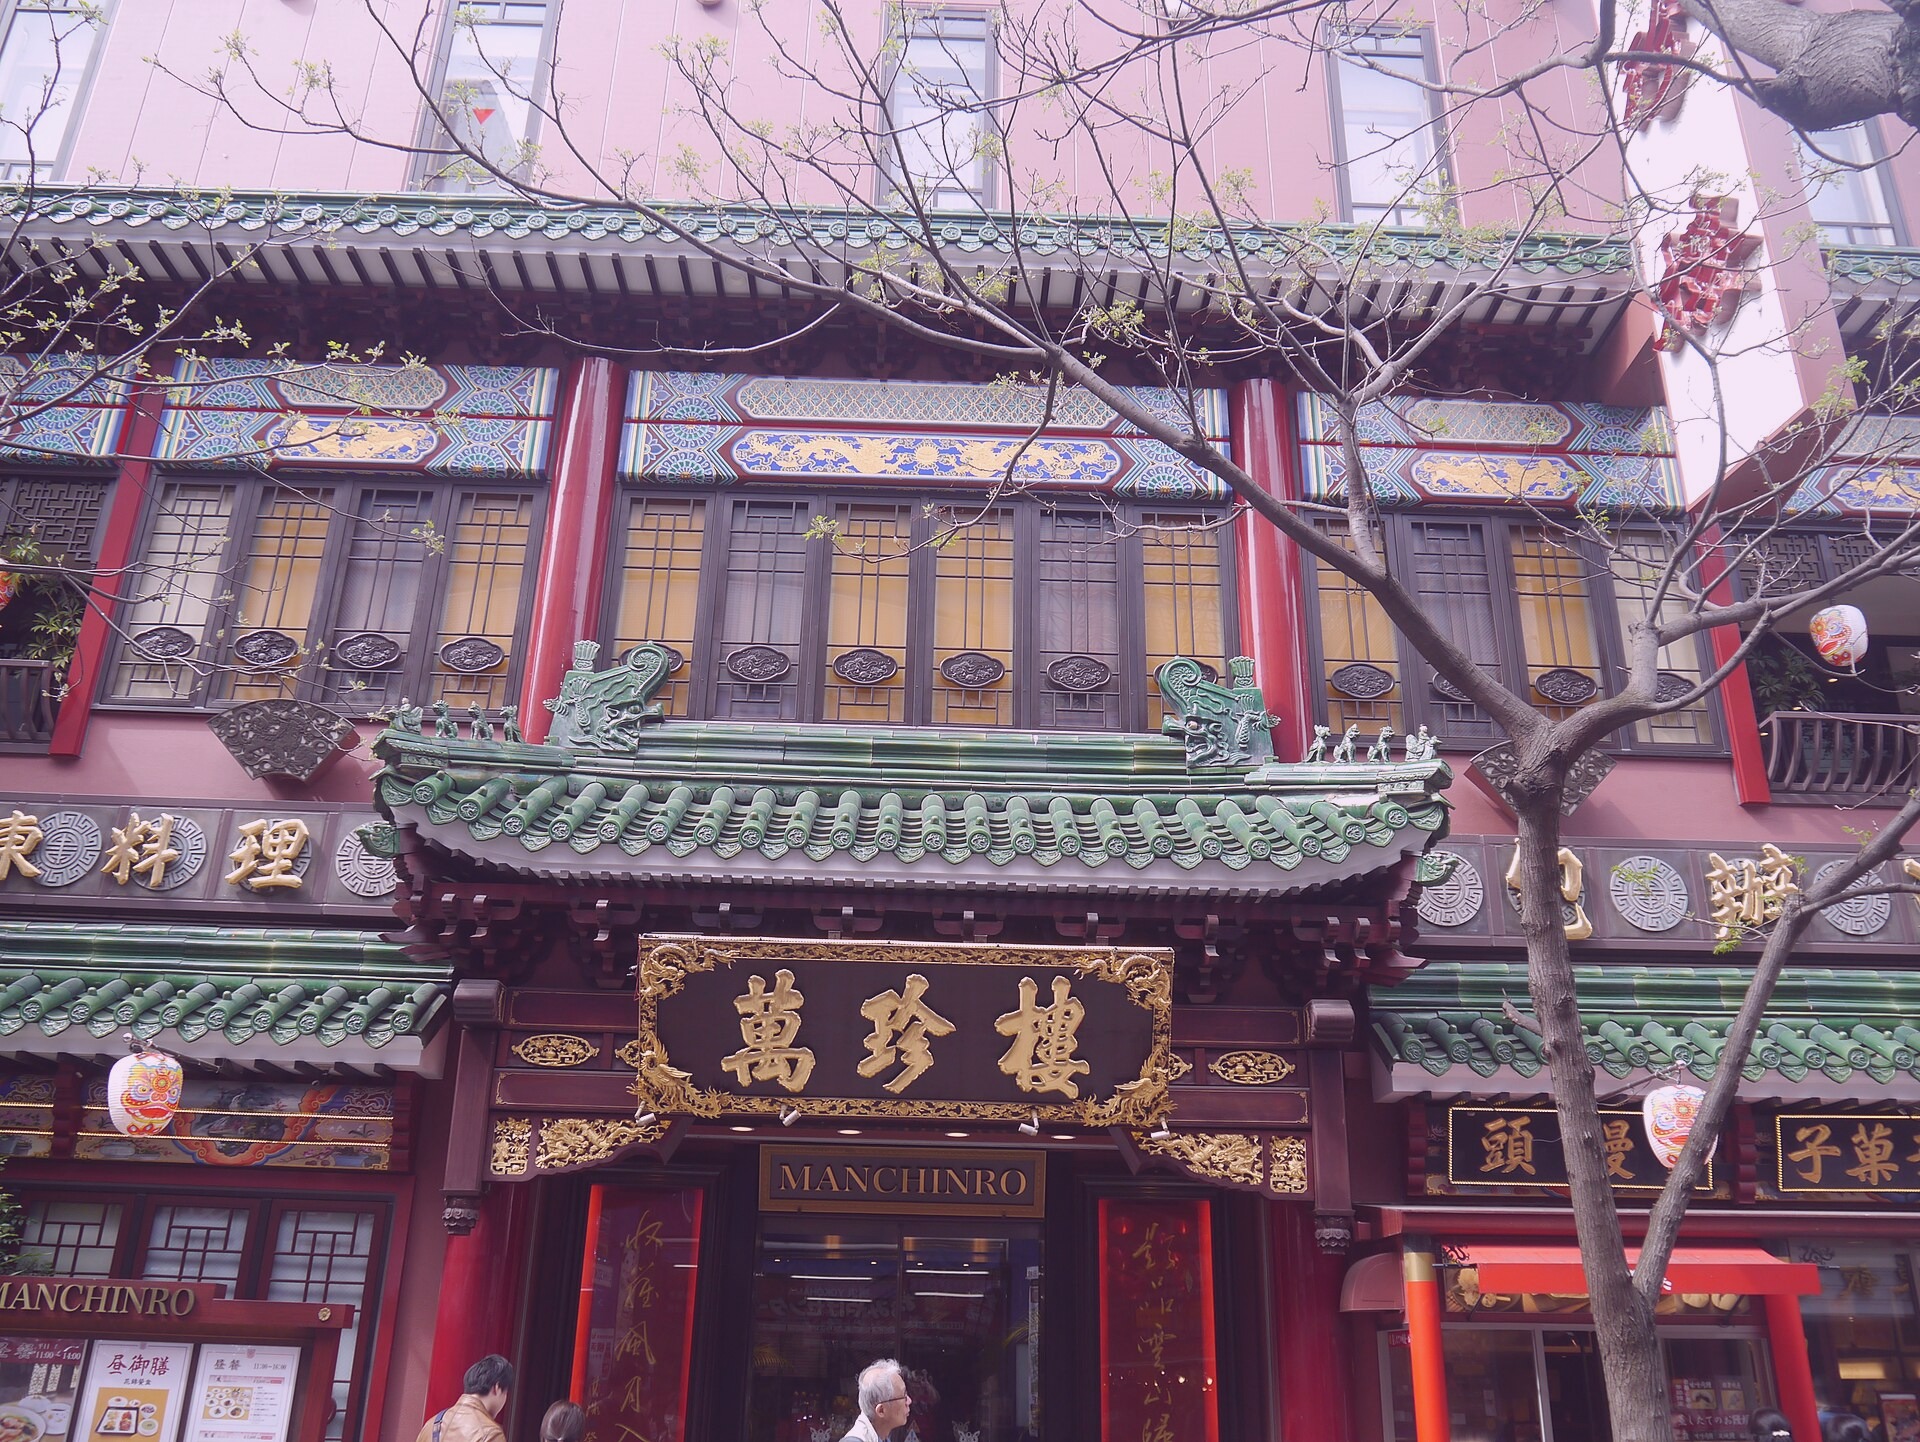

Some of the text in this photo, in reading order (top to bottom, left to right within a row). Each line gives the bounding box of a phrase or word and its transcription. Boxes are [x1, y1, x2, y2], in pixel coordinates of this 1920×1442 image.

[720, 968, 1091, 1099] 萬珍樓
[779, 1163, 1028, 1197] MANCHINRO
[107, 1354, 170, 1376] 昼御膳
